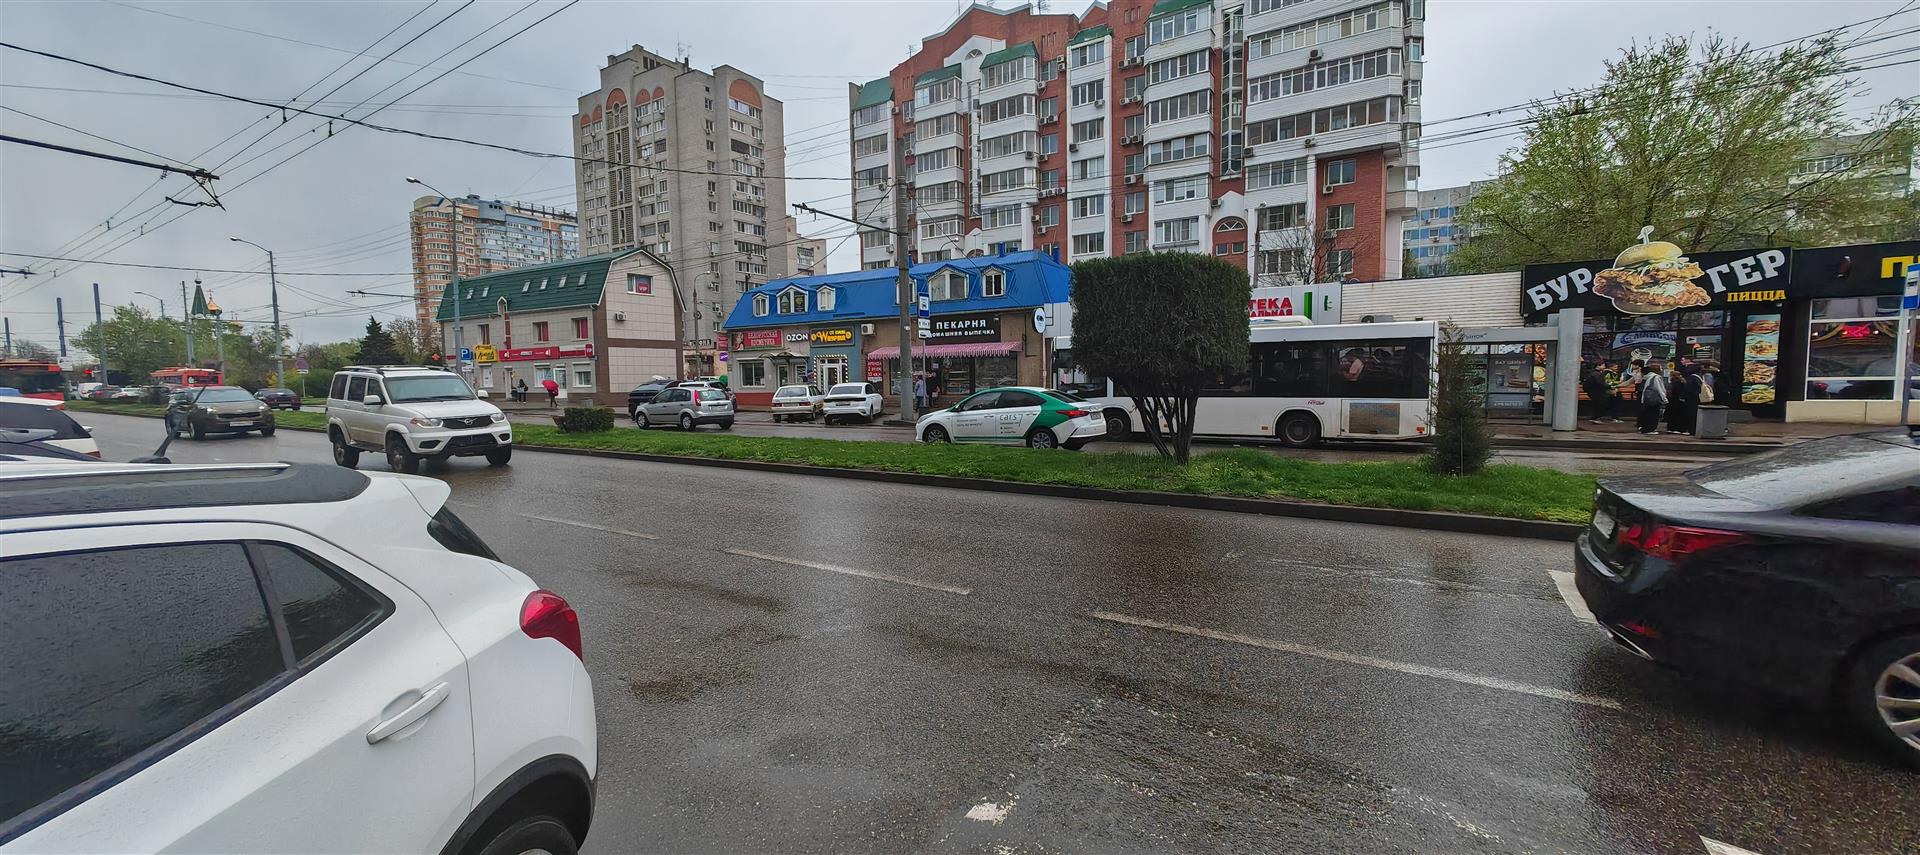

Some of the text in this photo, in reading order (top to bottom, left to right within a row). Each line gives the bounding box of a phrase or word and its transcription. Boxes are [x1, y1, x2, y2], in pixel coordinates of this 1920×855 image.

[1526, 249, 1786, 311] БУР ГЕР
[1726, 289, 1787, 303] ПИЦЦА
[936, 319, 986, 330] ПЕКАРНЯ
[786, 333, 809, 341] OZON
[461, 349, 469, 358] P
